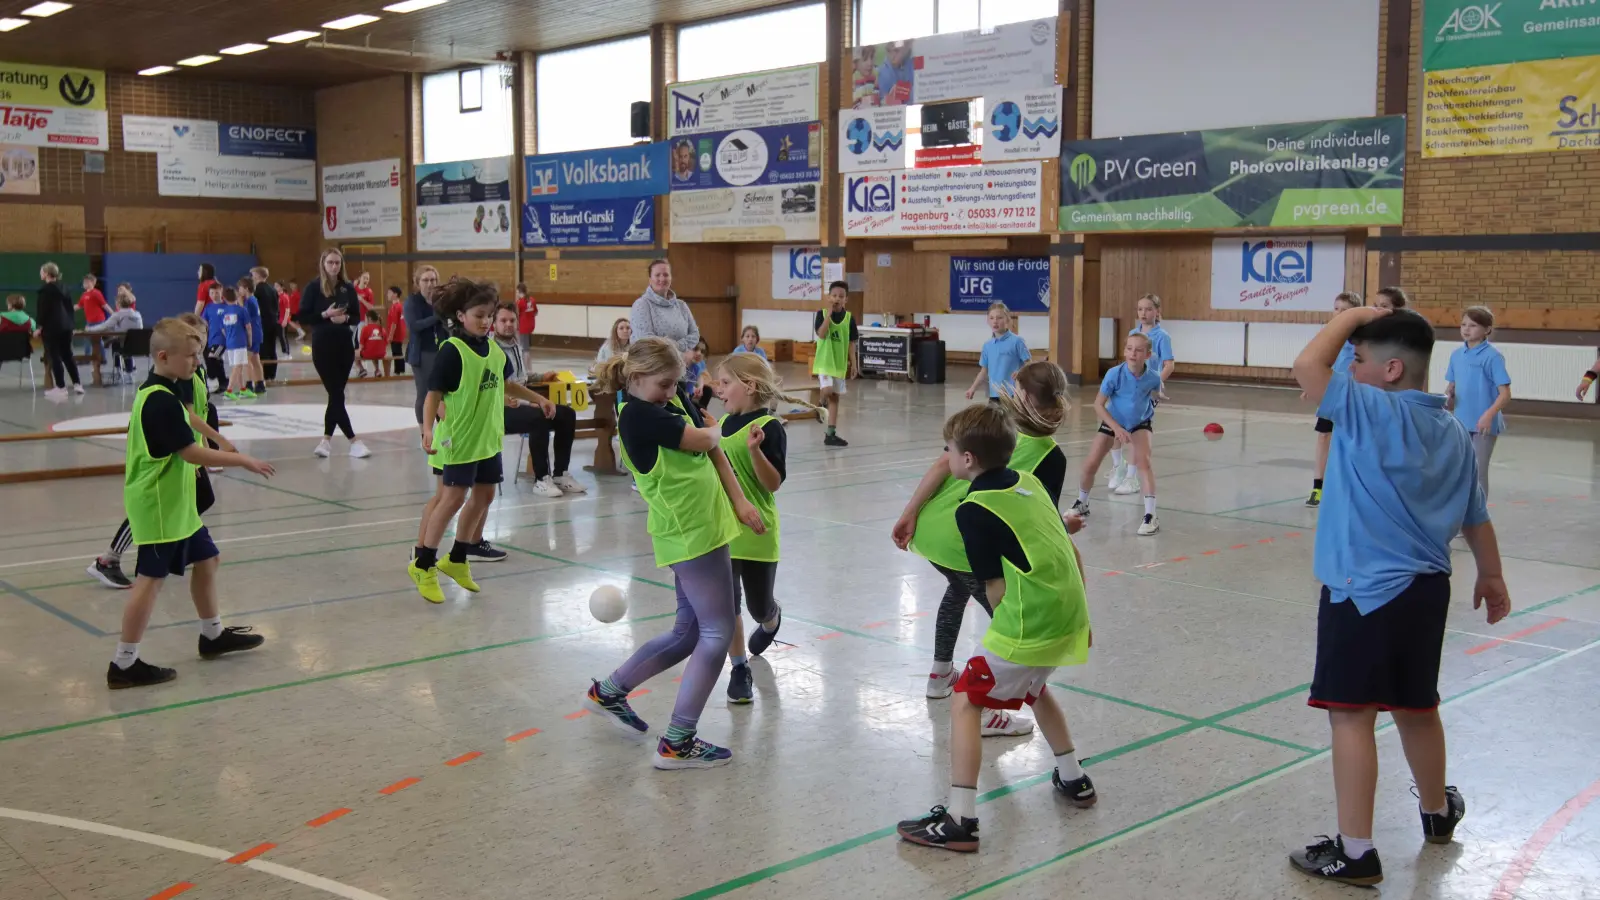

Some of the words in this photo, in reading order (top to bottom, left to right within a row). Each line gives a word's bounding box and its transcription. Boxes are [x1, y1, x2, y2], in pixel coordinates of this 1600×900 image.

[1437, 2, 1503, 36] AOK
[0, 70, 48, 90] ratung
[1427, 74, 1491, 86] Bedachungen
[1427, 85, 1516, 98] Dachfenstereinbau
[1426, 97, 1523, 111] Dachbeschichtungen
[0, 106, 53, 131] Tatje
[1425, 111, 1523, 124] Fassadenbekleidung
[228, 126, 307, 142] ENOFECT
[922, 123, 938, 133] HEIM
[947, 120, 967, 130] GÄSTE
[1425, 123, 1529, 137] Bauklempnerarbeiten
[1266, 136, 1305, 152] Deine
[1310, 129, 1390, 149] individuelle
[1425, 136, 1533, 149] Schornsteinbekleidung
[562, 154, 651, 185] Volksbank
[1104, 159, 1131, 181] PV
[1135, 157, 1197, 178] Green
[1229, 152, 1389, 174] Photovoltaikanlage
[205, 167, 267, 177] Physiotherapie
[907, 172, 941, 181] Installation
[970, 169, 982, 177] und
[983, 166, 1037, 177] Altbausanierung
[324, 182, 365, 194] Stadtsparkasse
[365, 177, 390, 189] Wunstorf
[848, 175, 895, 212] Kiel
[907, 182, 984, 193] Bad-Komplettrenovierung
[993, 180, 1036, 189] Heizungsbau
[907, 196, 941, 205] Ausstellung
[953, 192, 1036, 203] Störungs-/Wartungsdienst
[550, 211, 582, 225] Richard
[584, 208, 615, 224] Gurski
[900, 211, 949, 222] Hagenburg
[967, 208, 997, 218] 05033
[1071, 209, 1132, 223] Gemeinsam
[1136, 207, 1195, 223] nachhaltig.
[1293, 200, 1388, 220] pvgreen.de
[901, 223, 962, 231] www.kiel-sanitaer.de
[967, 221, 1036, 230] info@kiel-sanitaer.de
[953, 260, 971, 271] Wir
[973, 259, 995, 271] sind
[998, 259, 1014, 270] die
[1018, 258, 1049, 270] Förde
[1241, 240, 1313, 283] Kiel
[960, 277, 993, 294] JFG
[1240, 285, 1276, 302] Sanitär
[1264, 298, 1270, 307] &
[1274, 286, 1310, 303] Heizung
[575, 389, 584, 407] 0
[1321, 860, 1346, 876] FILA
